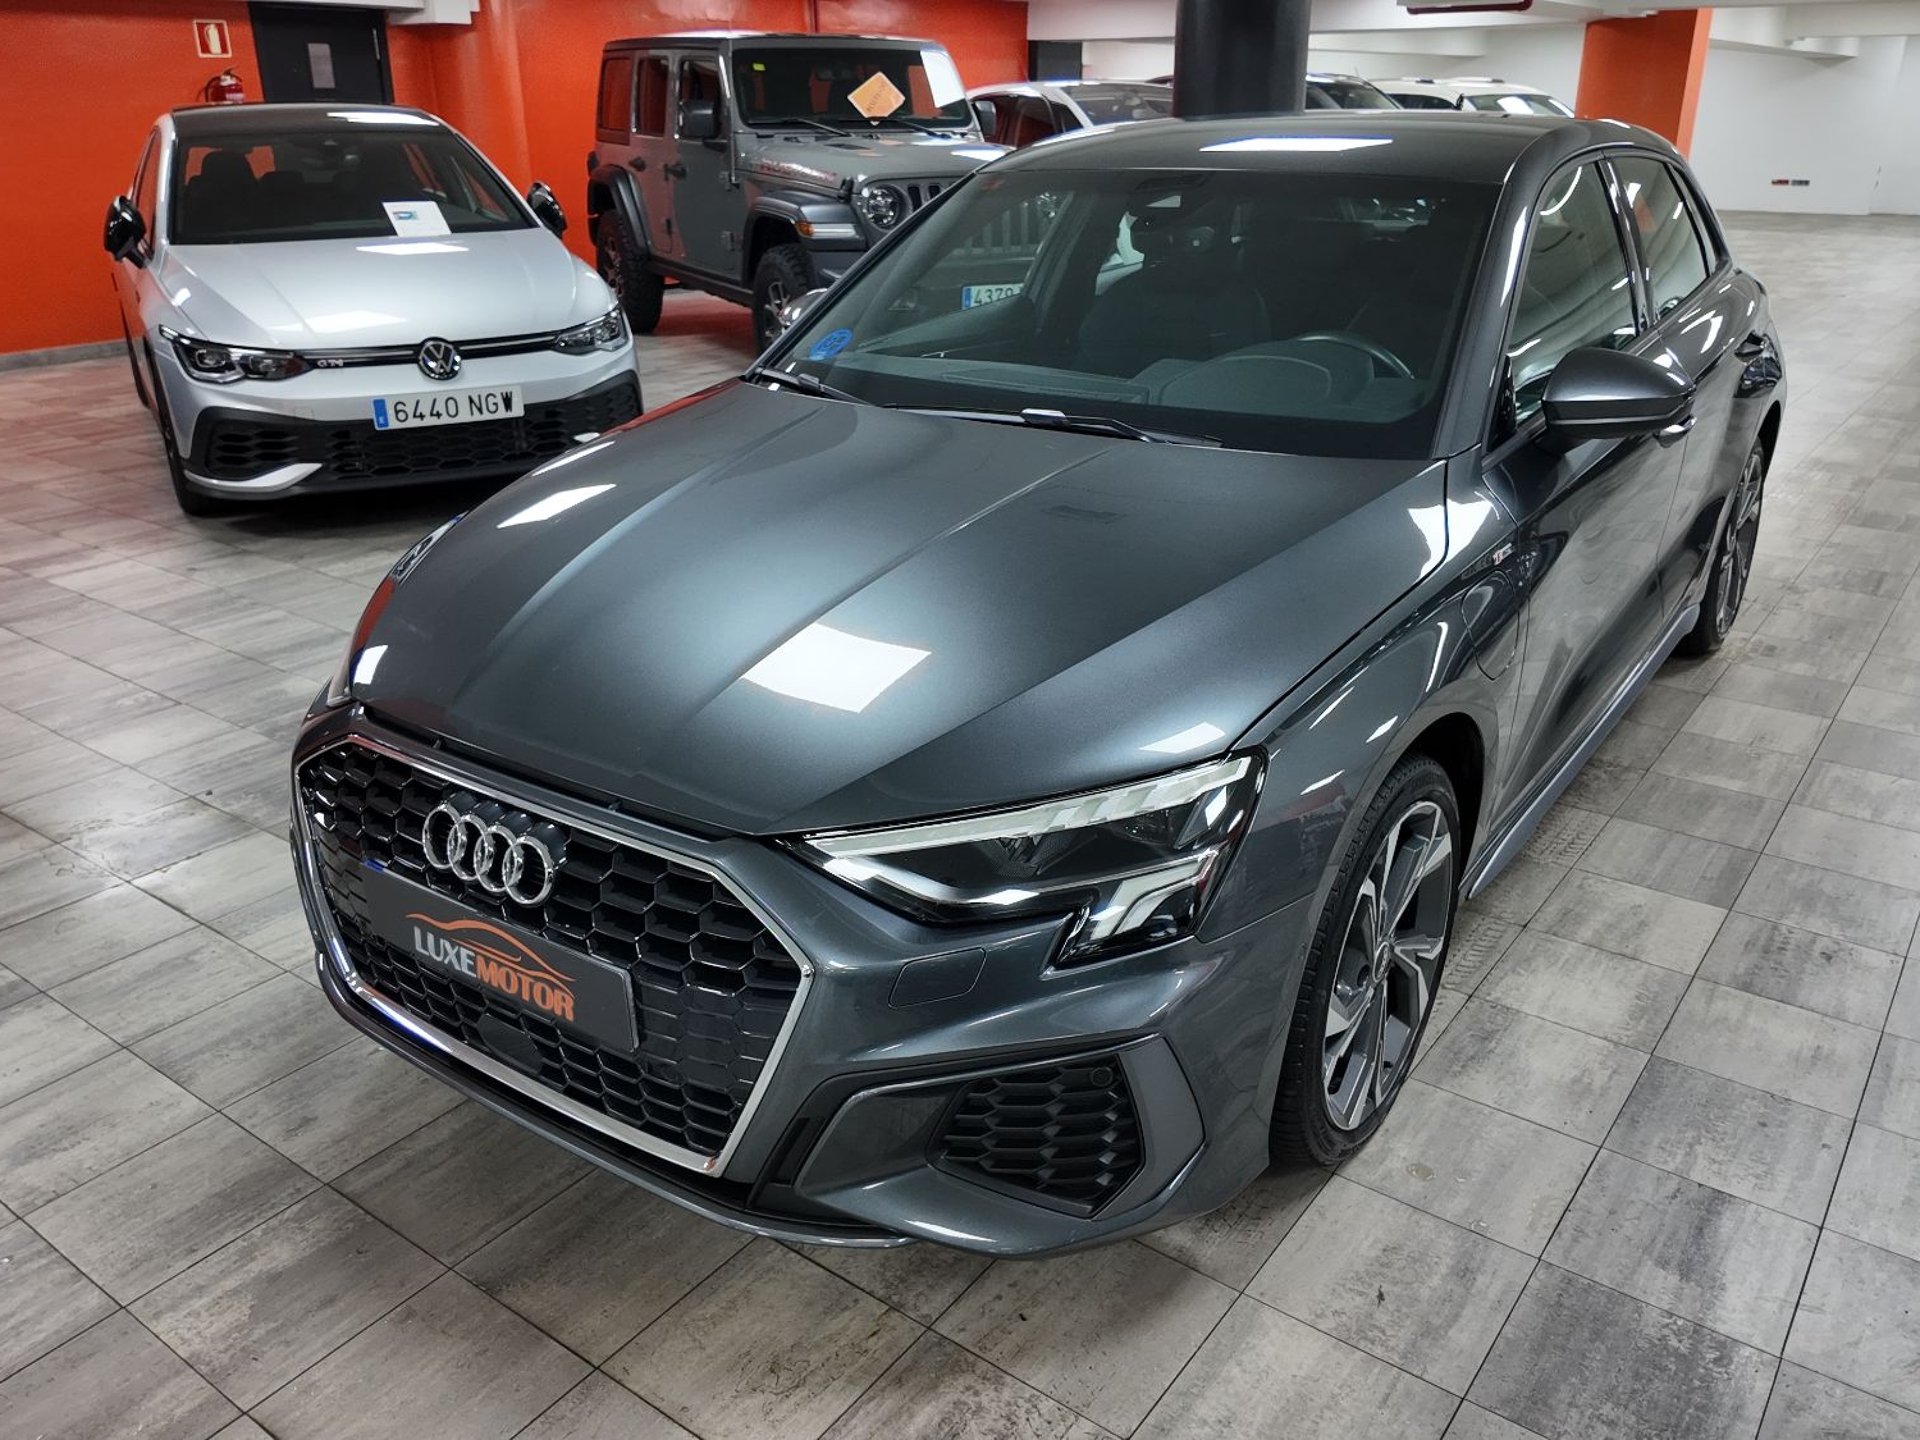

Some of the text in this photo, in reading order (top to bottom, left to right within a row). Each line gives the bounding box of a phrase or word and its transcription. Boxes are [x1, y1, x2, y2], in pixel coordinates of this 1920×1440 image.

[393, 391, 513, 423] 6440 NGW
[413, 925, 575, 1023] LUXEMOTOR
